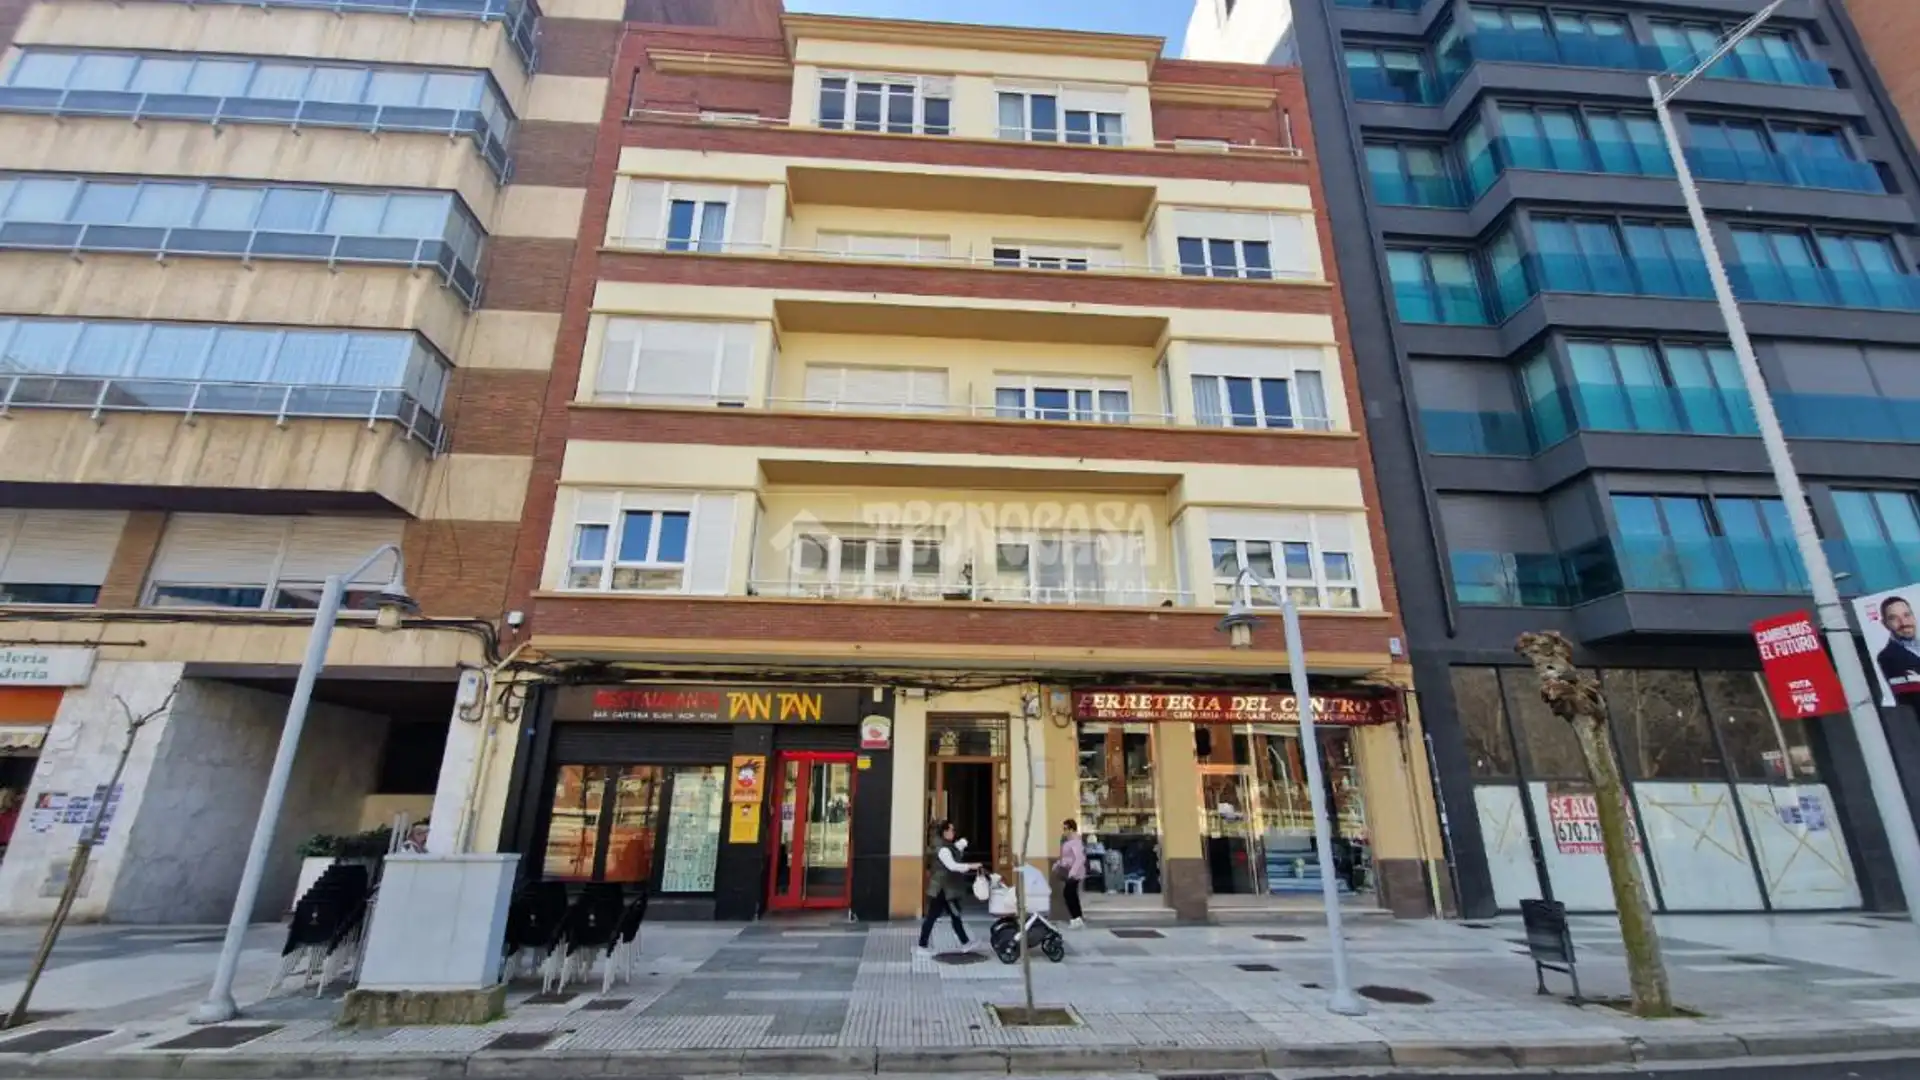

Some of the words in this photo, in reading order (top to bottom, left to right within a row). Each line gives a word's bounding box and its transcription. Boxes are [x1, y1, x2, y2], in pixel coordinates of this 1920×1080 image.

[1760, 644, 1776, 660] EL
[1773, 634, 1819, 657] FUTURO
[726, 692, 772, 720] TAN
[776, 692, 822, 721] TAN
[1079, 693, 1222, 712] FERRETERIA
[1230, 696, 1273, 712] DEL
[1279, 697, 1371, 714] CNTRO
[1551, 797, 1573, 818] SE
